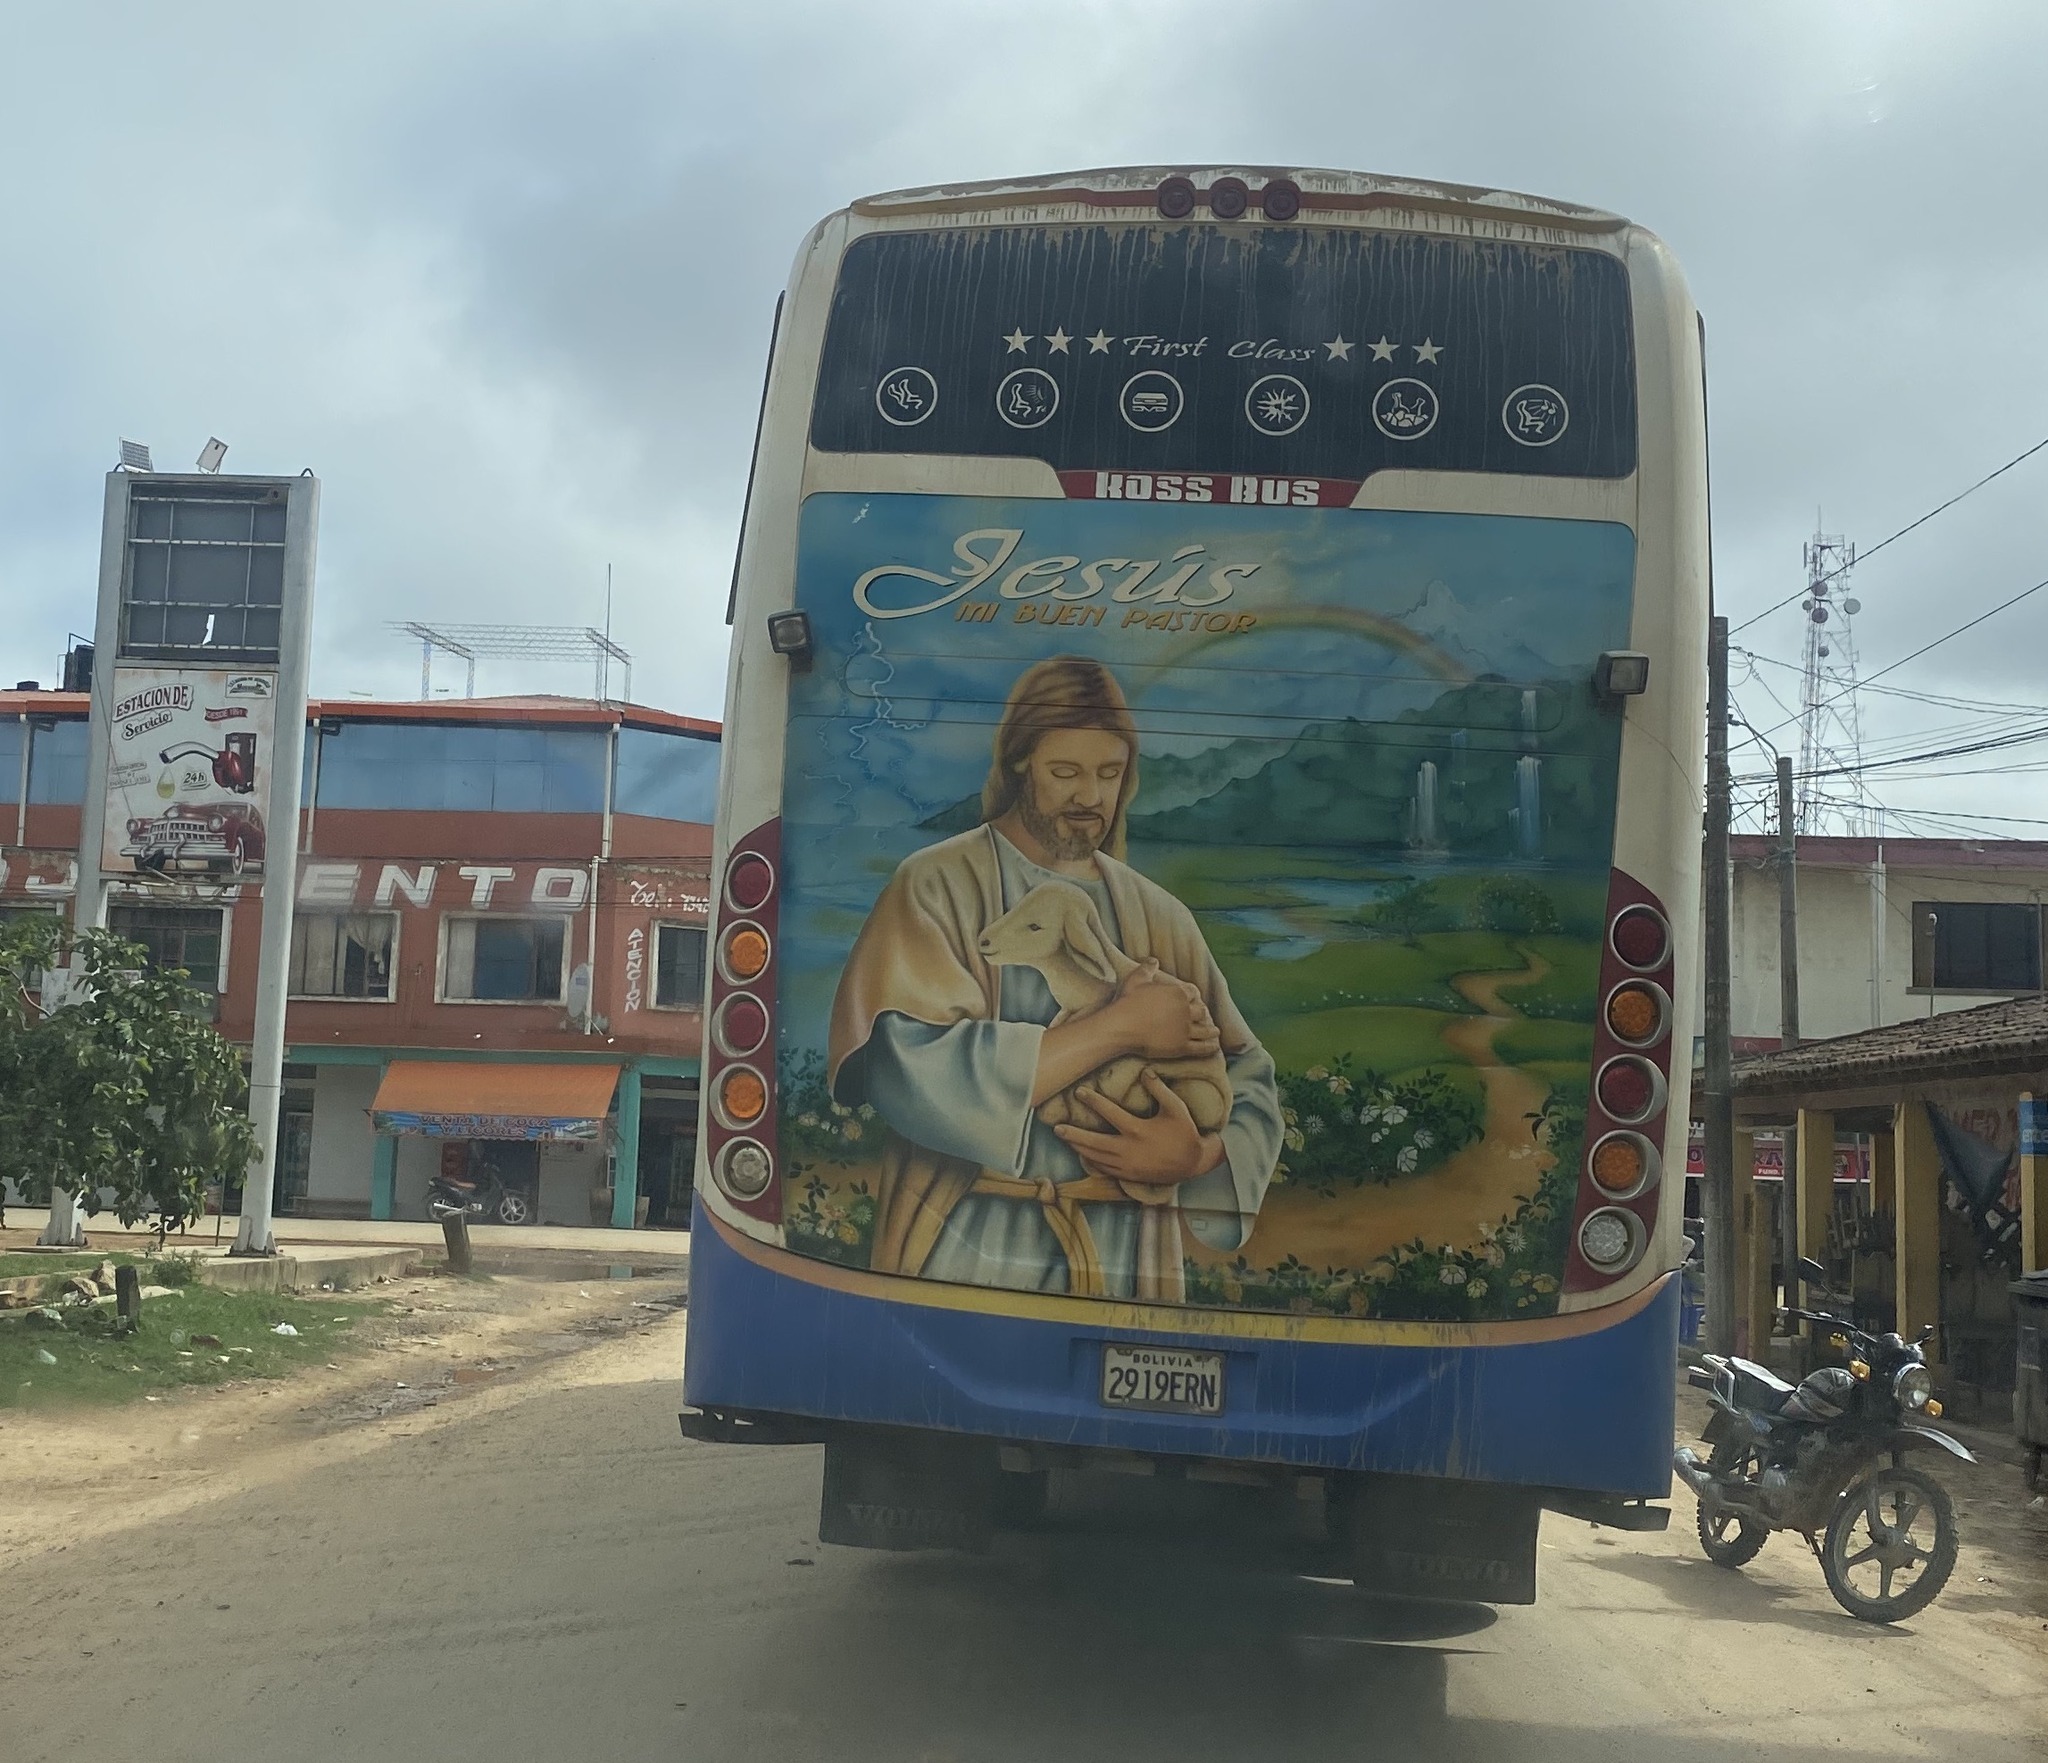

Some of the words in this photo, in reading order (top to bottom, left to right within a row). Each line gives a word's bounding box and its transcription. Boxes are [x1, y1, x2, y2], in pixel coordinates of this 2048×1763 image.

[1123, 335, 1209, 357] First
[1228, 338, 1316, 361] Class
[852, 528, 1262, 619] Jesús
[954, 601, 999, 621] MI
[1013, 603, 1107, 626] BUEN
[1121, 607, 1257, 634] PASTOR
[115, 689, 170, 718] ESTACION
[173, 685, 189, 707] DE
[125, 713, 170, 737] Servicio
[1133, 1353, 1193, 1368] BOLIVIA
[1108, 1366, 1216, 1408] 2919ERN
